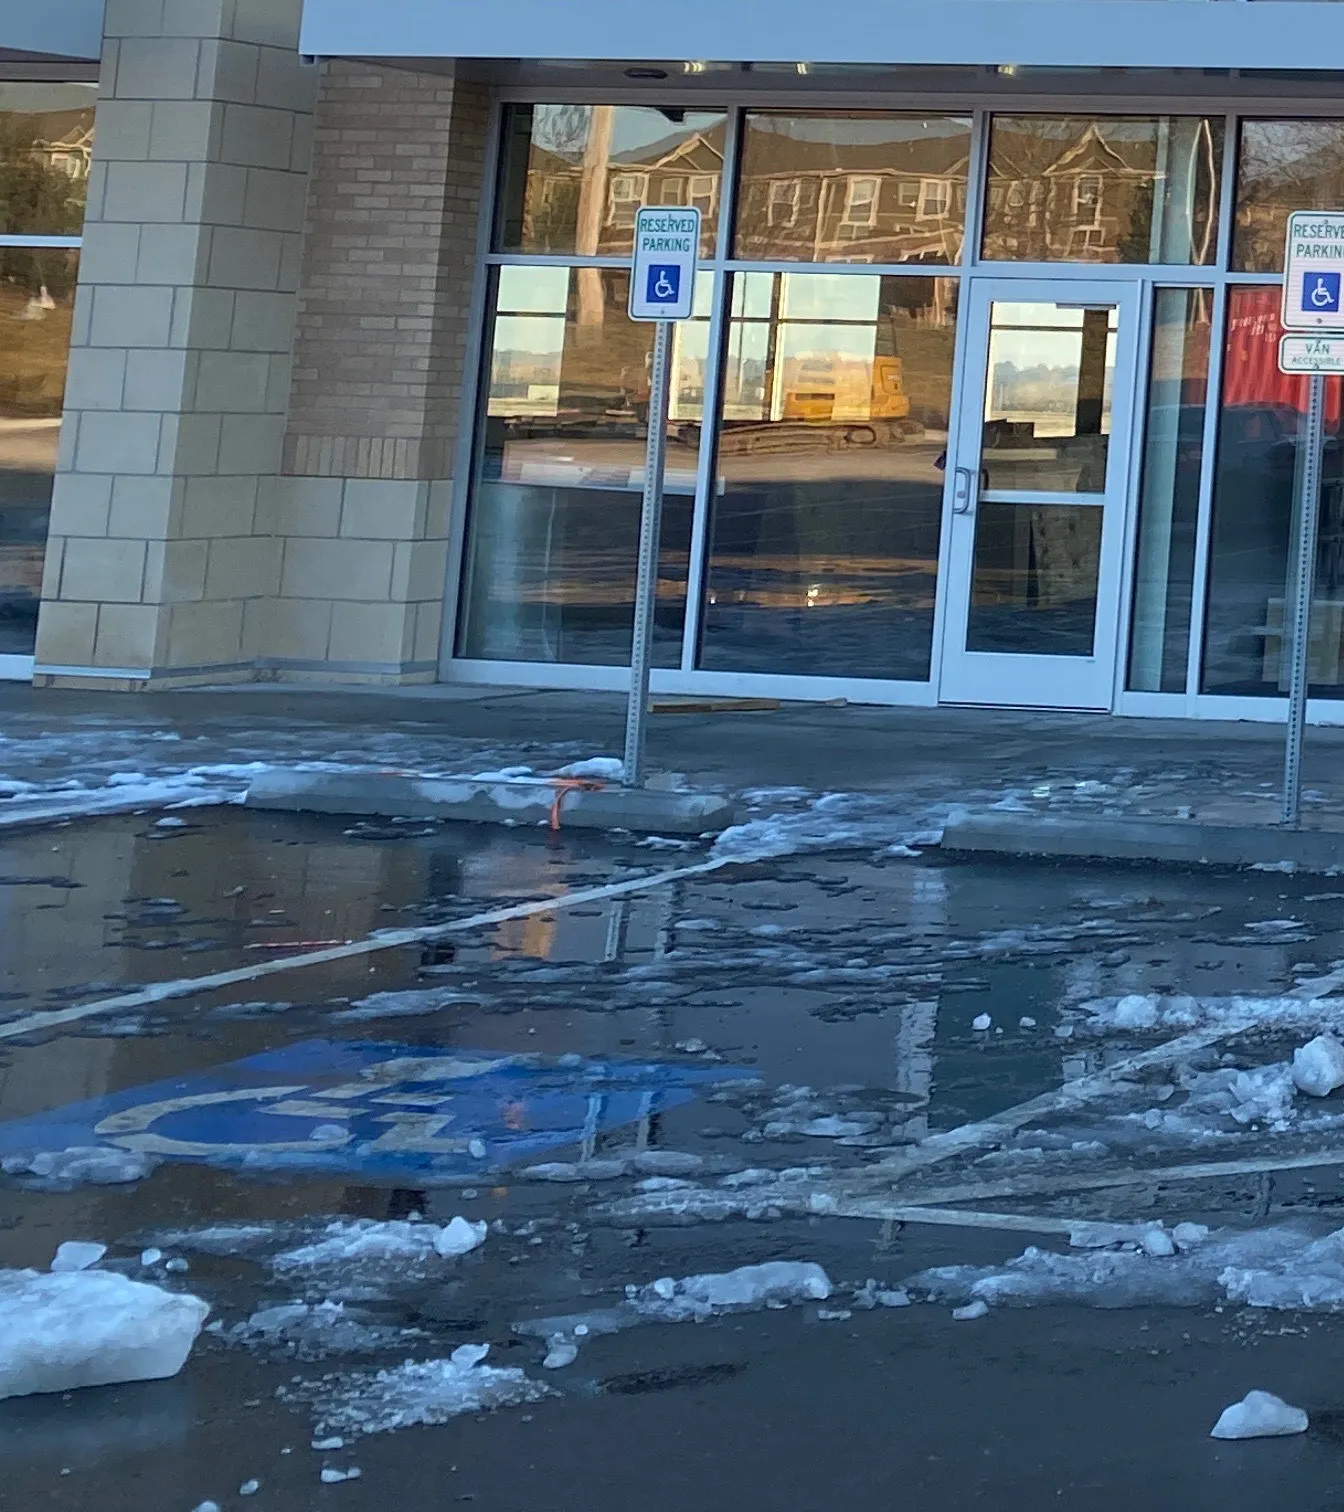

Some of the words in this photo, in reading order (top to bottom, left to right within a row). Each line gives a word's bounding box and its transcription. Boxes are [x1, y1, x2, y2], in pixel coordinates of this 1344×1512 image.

[640, 218, 695, 233] RESERVED
[642, 238, 690, 252] PARKING
[1305, 344, 1330, 355] VAN
[1292, 357, 1342, 365] ACCESSIBLE
